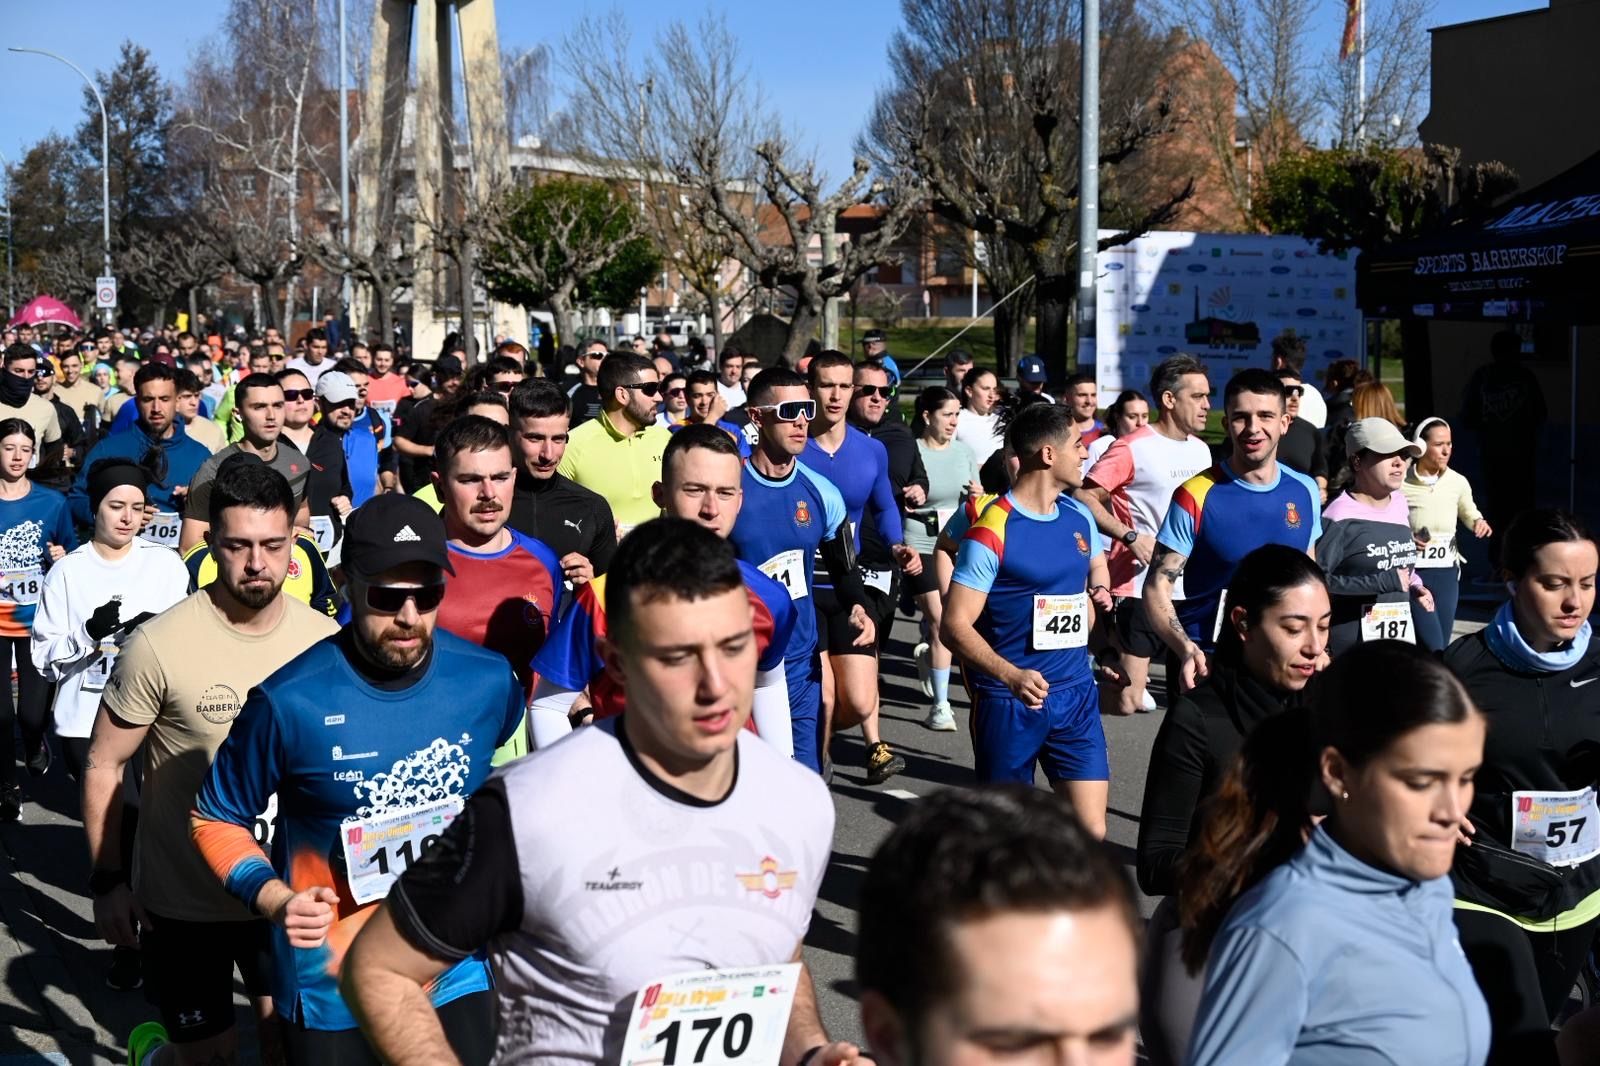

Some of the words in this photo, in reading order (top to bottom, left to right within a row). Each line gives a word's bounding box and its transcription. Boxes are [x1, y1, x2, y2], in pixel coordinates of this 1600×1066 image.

[1414, 254, 1467, 275] SPORTS
[1471, 245, 1567, 272] BARBERSHOP
[149, 524, 178, 538] 105
[1366, 543, 1389, 557] San
[5, 580, 38, 597] 118
[1046, 614, 1081, 634] 428
[1375, 620, 1408, 639] 187
[347, 827, 362, 845] 10
[1545, 816, 1587, 848] 57
[640, 983, 662, 1009] 10
[655, 1012, 753, 1066] 170
